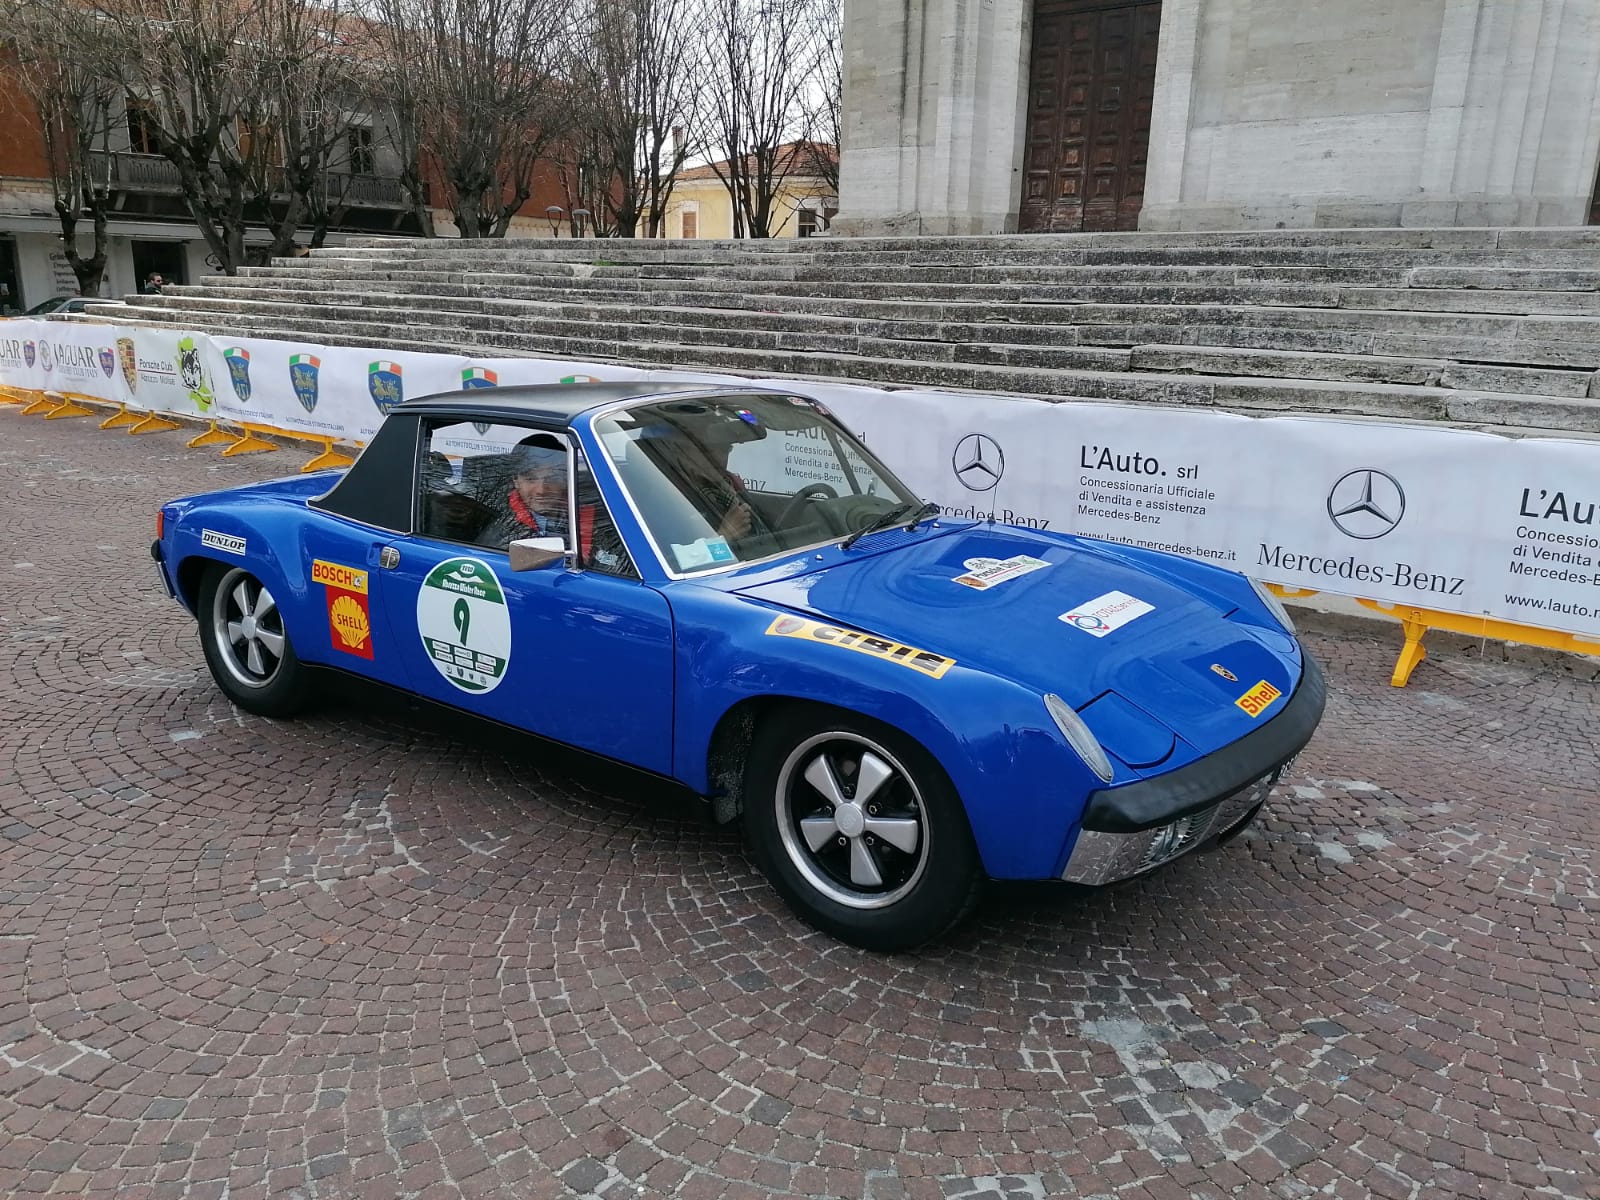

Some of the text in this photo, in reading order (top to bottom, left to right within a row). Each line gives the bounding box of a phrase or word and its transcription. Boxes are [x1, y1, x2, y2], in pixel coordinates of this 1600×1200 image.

[53, 343, 97, 369] JAGUAR
[139, 358, 173, 371] Porsche Club
[784, 456, 792, 464] di
[793, 456, 822, 468] Vendita
[1177, 464, 1199, 480] srl
[784, 467, 843, 483] Mercedes-Benz
[1079, 476, 1215, 501] Concessionaria Ufficiale
[1077, 504, 1161, 525] Mercedes-Benz
[1078, 491, 1206, 516] di Vendita e assistenza
[1519, 487, 1600, 525] L'Au
[202, 533, 246, 551] DUNLOP
[1516, 525, 1600, 549] Concessio
[1512, 544, 1592, 567] di Vendita
[312, 562, 352, 586] BOSCH
[1256, 542, 1466, 597] Mercedes-Benz
[336, 613, 364, 631] SHELL
[453, 597, 471, 648] 9
[812, 626, 946, 672] CIBIE
[1239, 682, 1279, 714] Shell
